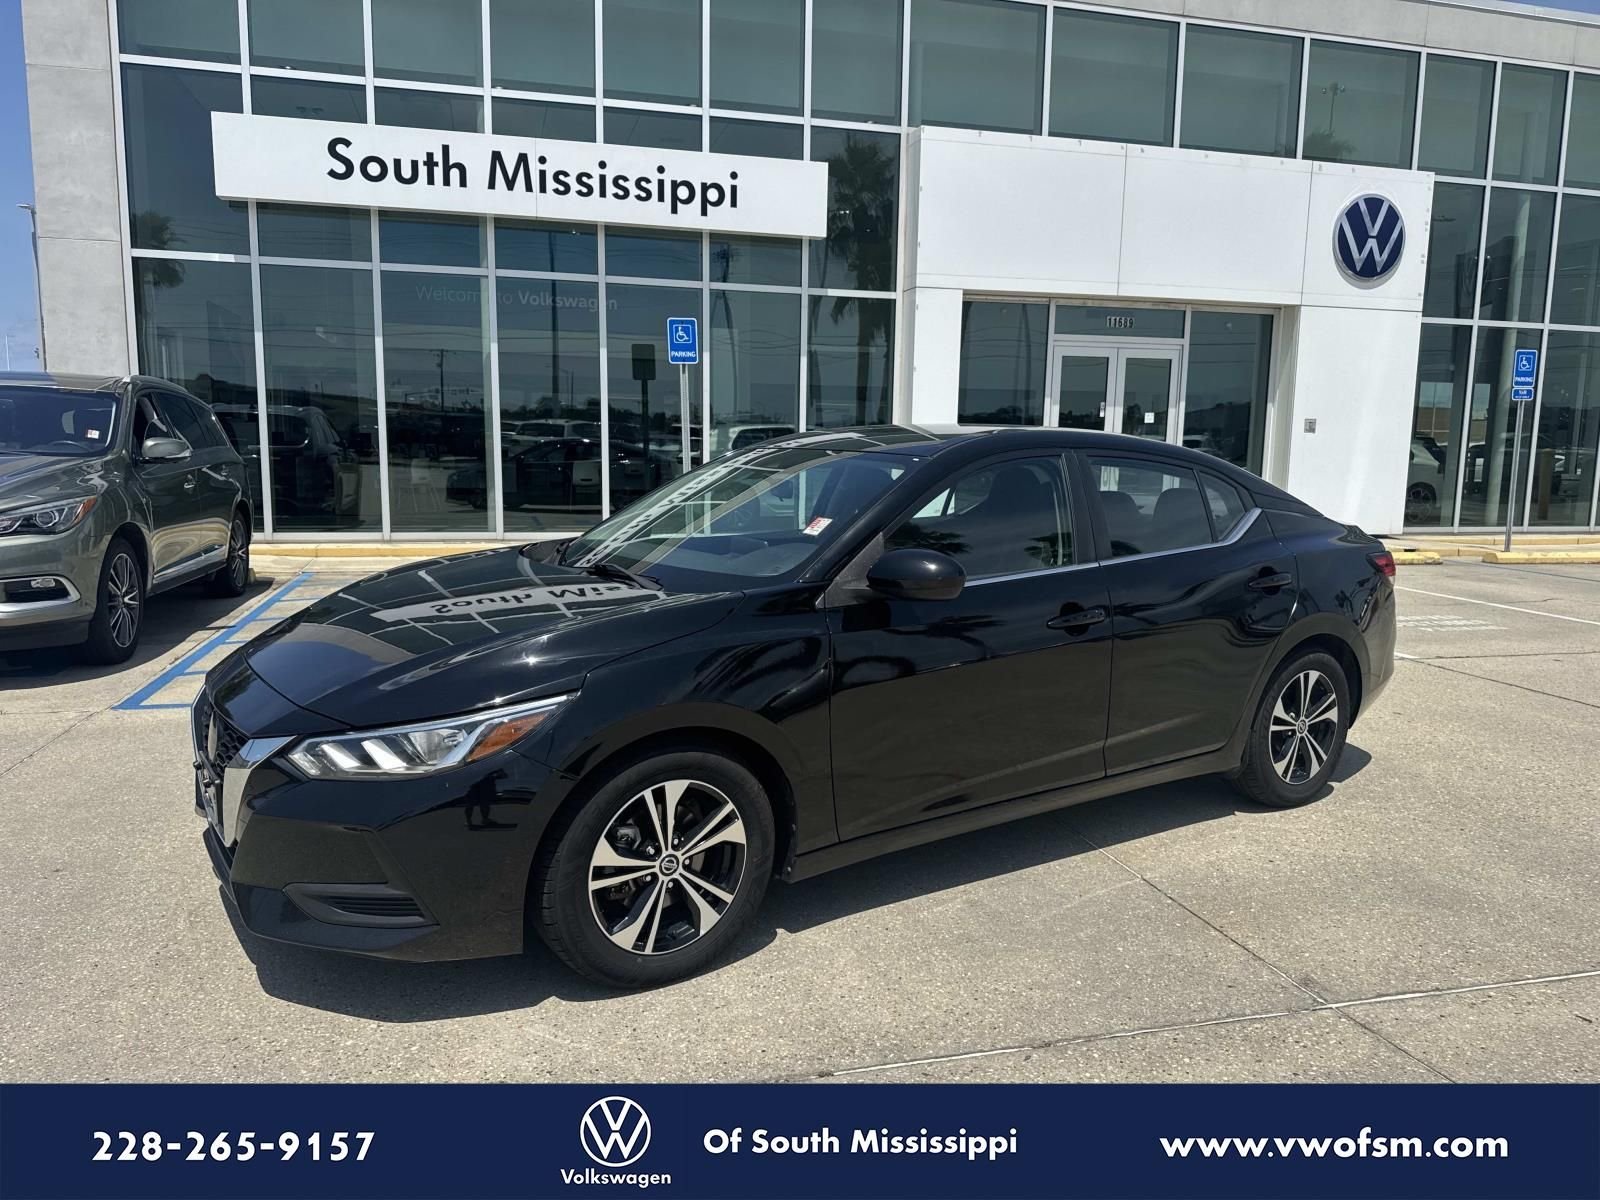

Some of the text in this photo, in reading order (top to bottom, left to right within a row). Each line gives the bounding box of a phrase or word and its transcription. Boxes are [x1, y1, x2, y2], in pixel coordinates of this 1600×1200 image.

[327, 137, 739, 217] South Mississippi
[1107, 317, 1135, 329] 11689
[671, 350, 696, 358] PARKING
